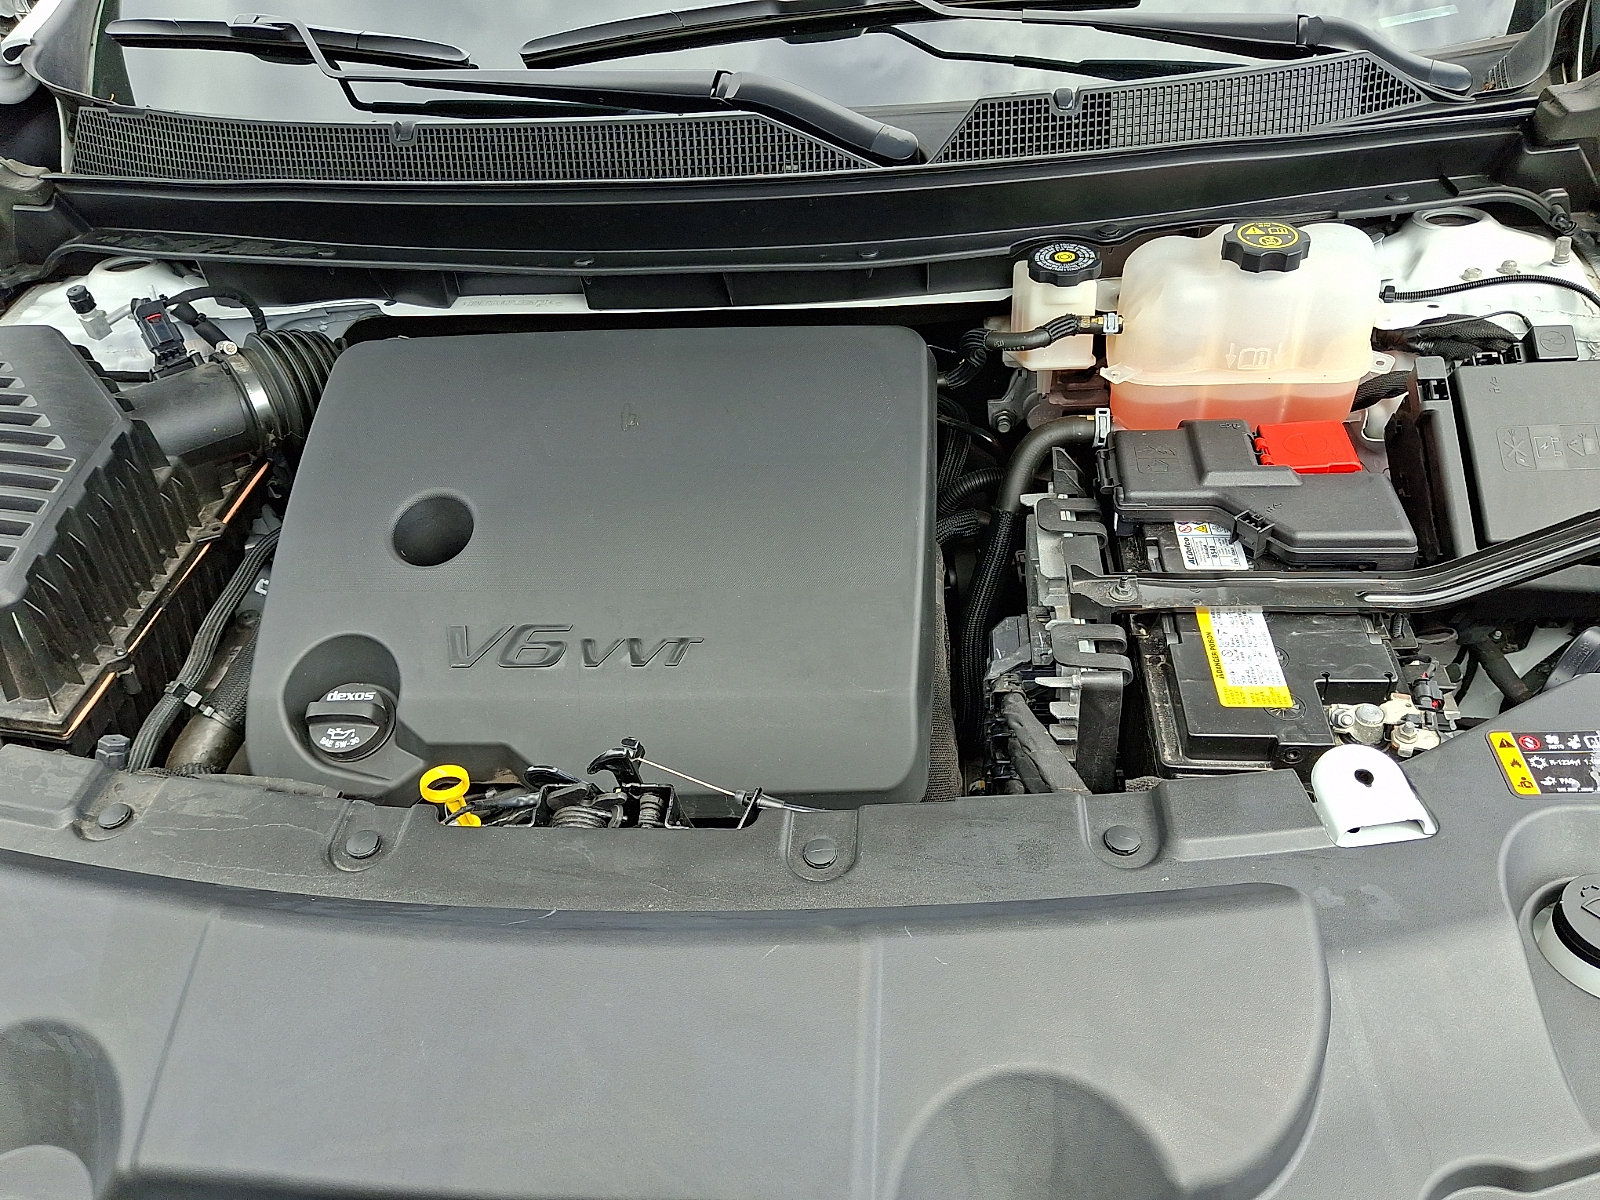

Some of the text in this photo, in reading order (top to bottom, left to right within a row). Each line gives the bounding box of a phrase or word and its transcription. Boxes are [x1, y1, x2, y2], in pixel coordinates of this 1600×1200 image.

[446, 623, 704, 668] V6 VVT
[326, 691, 376, 701] dexos
[320, 737, 334, 748] SAE
